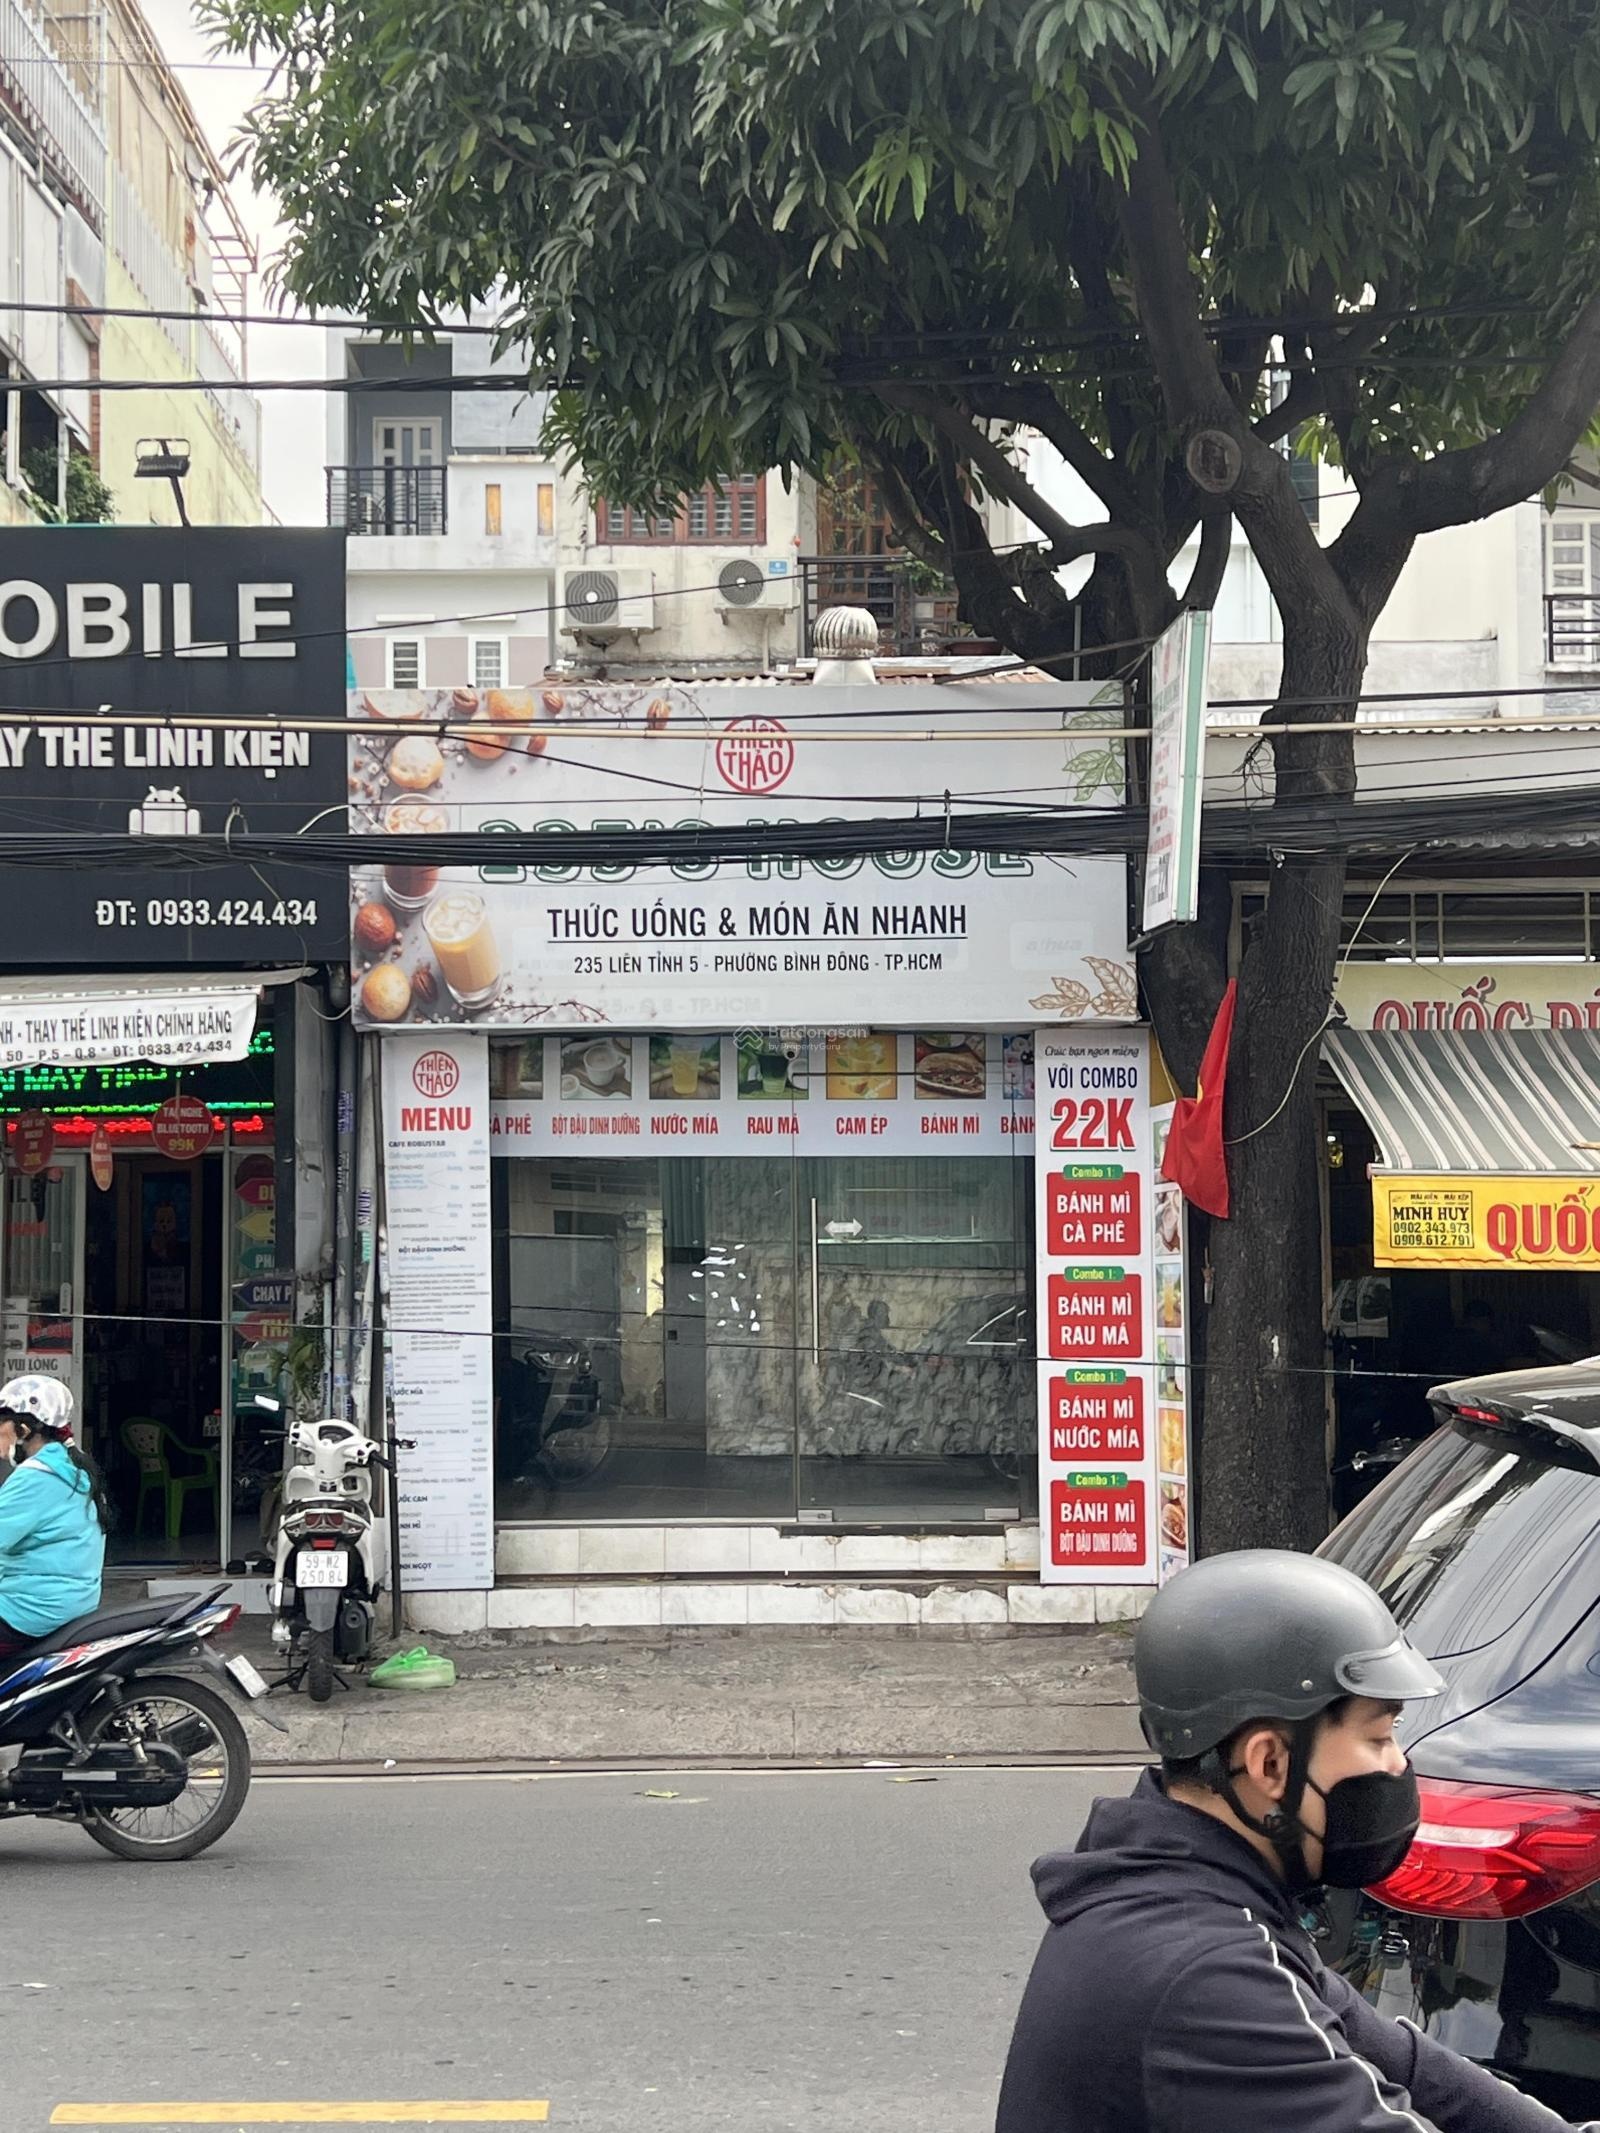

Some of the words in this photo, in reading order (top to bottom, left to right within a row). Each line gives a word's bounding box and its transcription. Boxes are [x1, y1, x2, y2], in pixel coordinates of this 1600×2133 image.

[124, 727, 214, 768] LINH
[723, 749, 783, 788] THẢO
[96, 900, 138, 926] ĐT:
[147, 899, 318, 926] 0933.424.434
[547, 902, 619, 938] THỨC
[632, 896, 706, 937] UỐNG
[719, 908, 737, 936] &
[748, 901, 810, 937] MÓN
[823, 902, 860, 936] ĂN
[872, 904, 967, 935] NHANH
[574, 957, 602, 974] 235
[610, 951, 642, 973] LIÊN
[648, 950, 683, 973] TỈNH
[689, 956, 699, 972] 5
[714, 954, 777, 972] PHƯỜNG
[784, 952, 820, 972] BÌNH
[826, 952, 869, 972] ĐÔNG
[884, 953, 943, 971] TP.HCM
[25, 1019, 58, 1043] THAY
[62, 1008, 88, 1041] THẾ
[91, 1016, 119, 1039] LINH
[123, 1009, 152, 1043] KIỆN
[156, 1007, 193, 1037] CHÍNH
[38, 1049, 60, 1061] P.5
[1048, 1064, 1073, 1088] VỚI
[1081, 1067, 1138, 1088] COMBO
[156, 1122, 210, 1134] BLUETOOTH
[402, 1107, 472, 1132] MENU
[505, 1113, 532, 1135] PHÊ
[589, 1117, 609, 1135] DINH
[651, 1112, 688, 1135] NƯỚC
[692, 1112, 719, 1135] MÍA
[747, 1116, 773, 1135] RAU
[836, 1116, 867, 1135] CAM
[871, 1113, 888, 1135] ÉP
[921, 1113, 958, 1134] BÁNH
[963, 1113, 980, 1134] MÌ
[1051, 1097, 1136, 1151] 22K
[1071, 1166, 1103, 1179] Combo
[1057, 1190, 1104, 1214] BÁNH
[1110, 1190, 1131, 1214] MÌ
[1393, 1206, 1433, 1220] MINH
[1437, 1206, 1470, 1220] HUY
[1062, 1220, 1086, 1243] CÀ
[1092, 1220, 1125, 1243] PHÊ
[1393, 1222, 1470, 1234] 0902.343.973
[1394, 1234, 1471, 1246] 0909.612.791
[254, 1253, 275, 1269] PH
[1072, 1268, 1105, 1280] Combo
[1058, 1293, 1105, 1316] BÁNH
[1112, 1293, 1132, 1316] MÌ
[1061, 1326, 1096, 1345] RAU
[1102, 1322, 1130, 1345] MÁ
[1074, 1370, 1107, 1382] Combo
[1059, 1396, 1106, 1419] BÁNH
[1113, 1395, 1133, 1419] MÌ
[1053, 1425, 1101, 1448] NƯỚC
[1107, 1426, 1140, 1448] MÍA
[1075, 1474, 1109, 1486] Combo
[1061, 1498, 1108, 1523] BÁNH
[1115, 1498, 1136, 1523] MÌ
